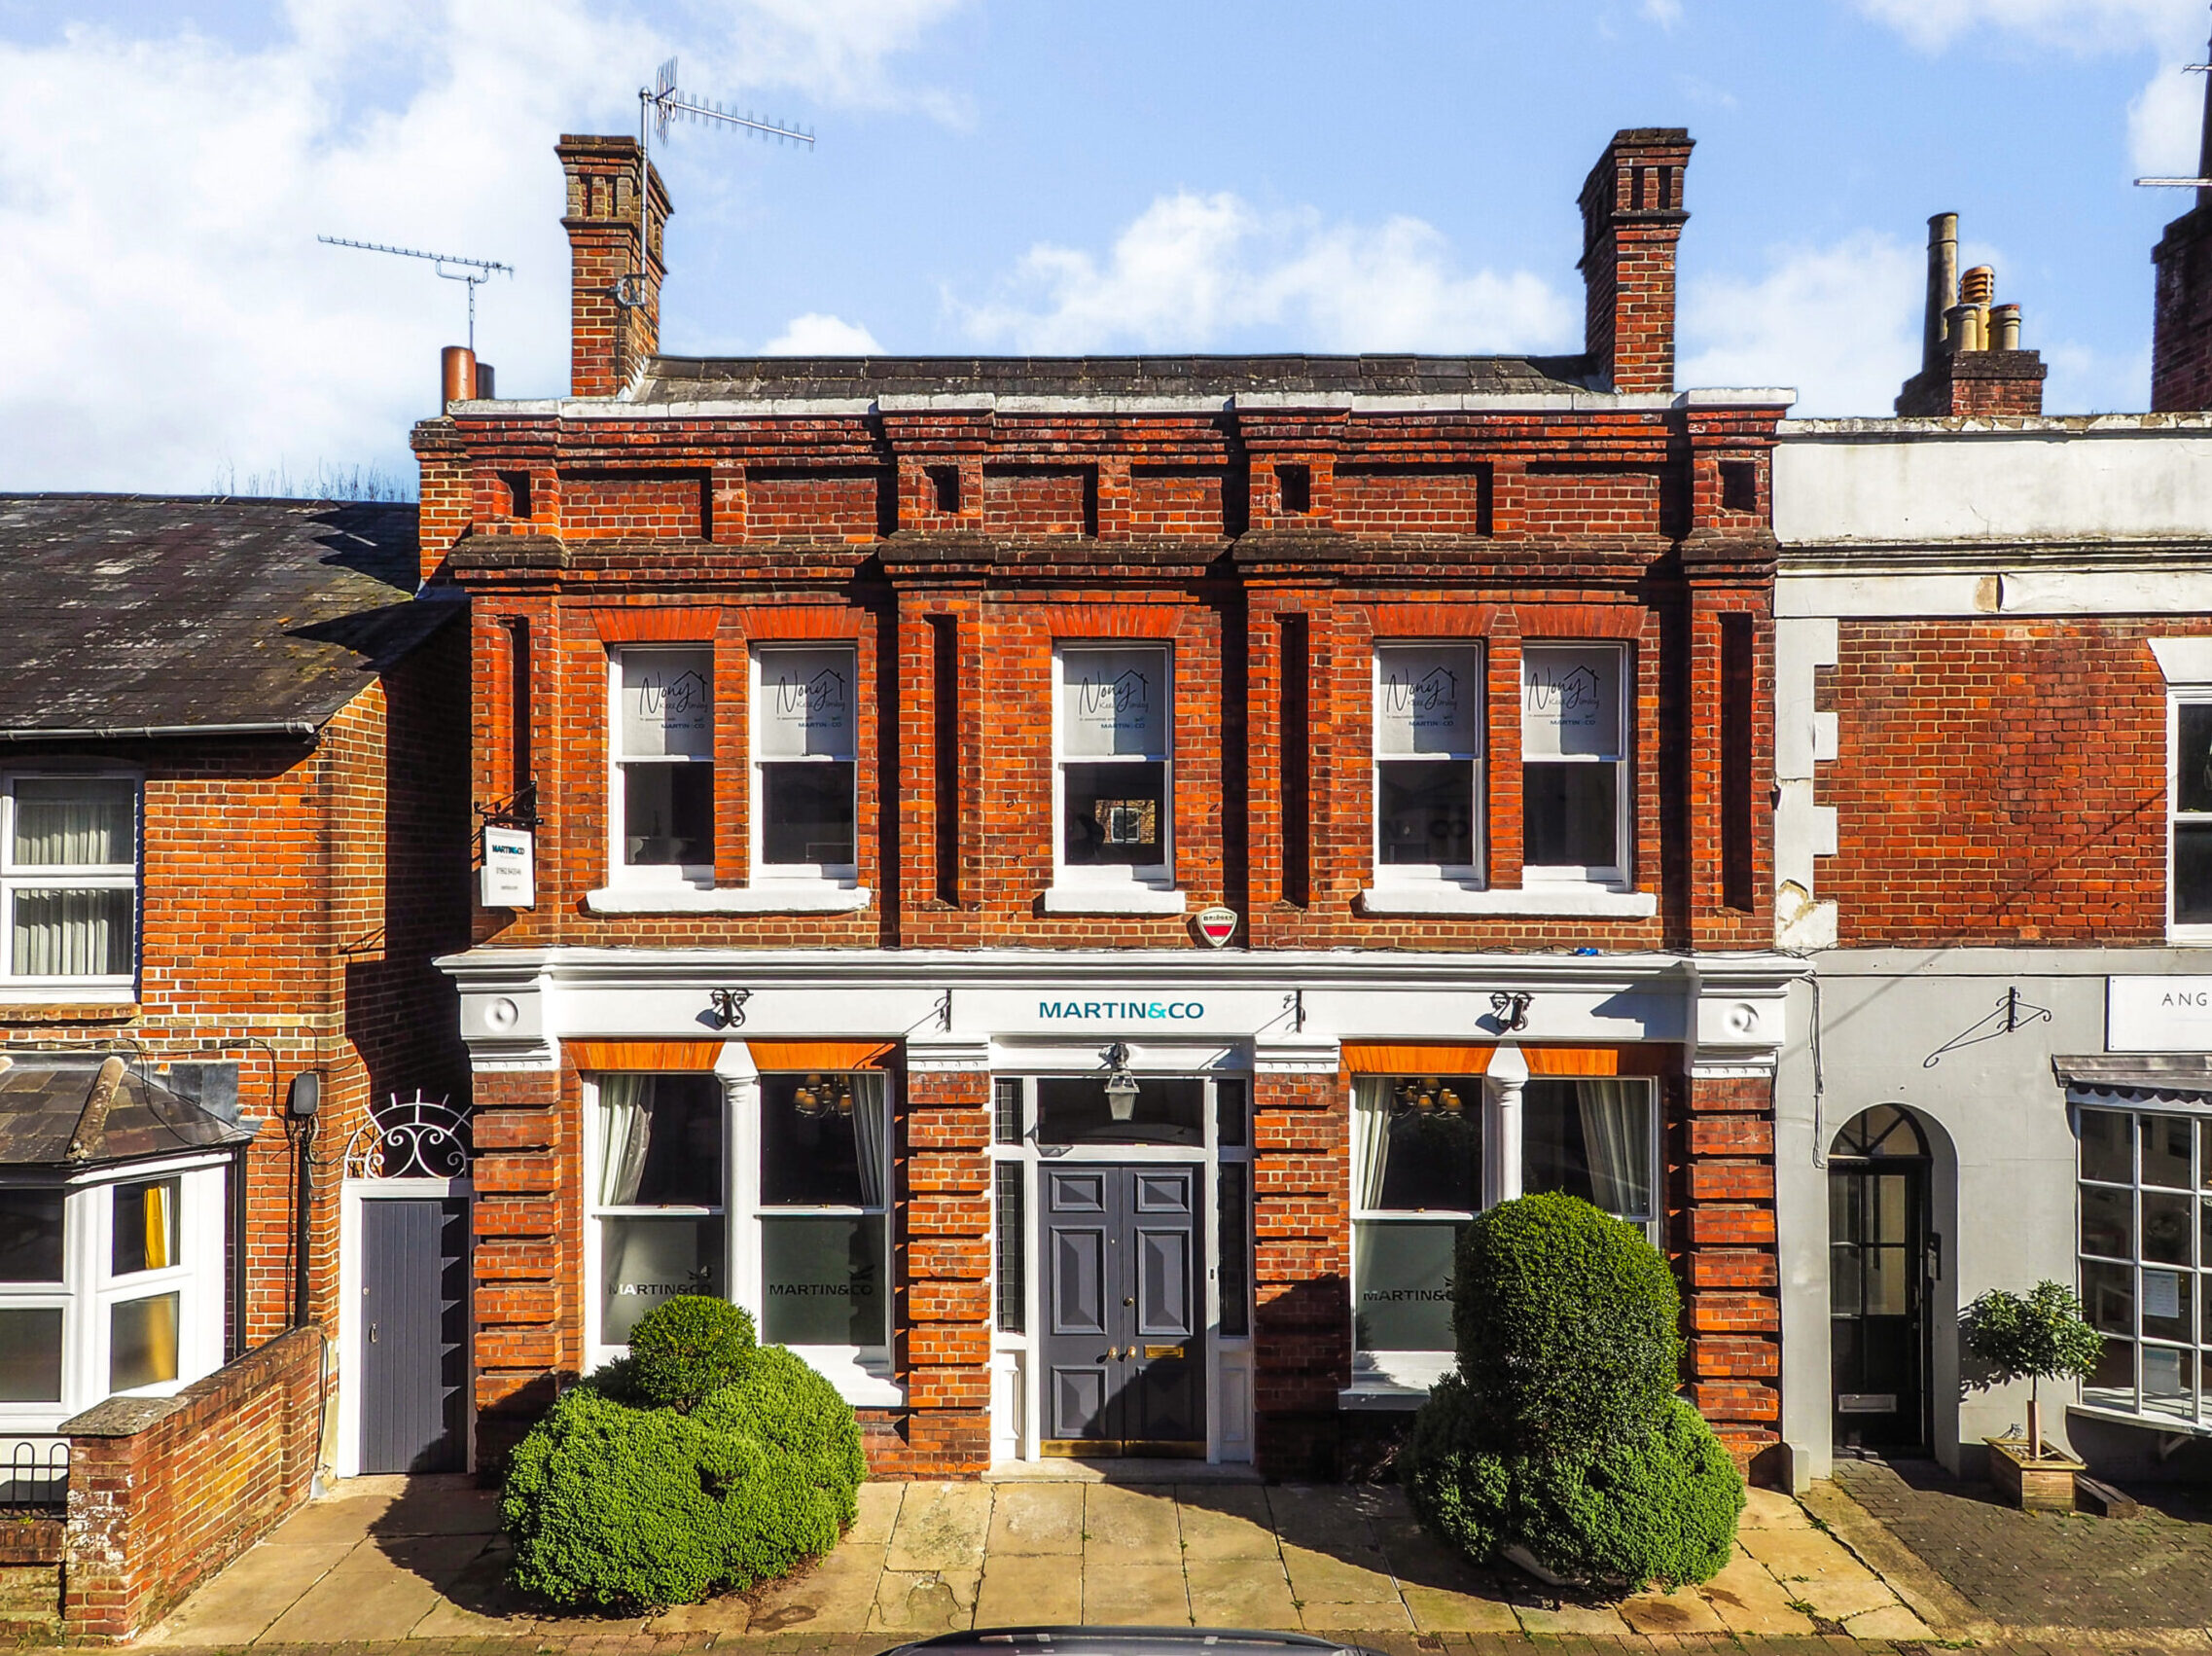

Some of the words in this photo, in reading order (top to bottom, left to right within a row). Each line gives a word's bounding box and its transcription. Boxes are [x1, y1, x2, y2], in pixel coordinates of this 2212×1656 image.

[639, 671, 696, 715] Nony
[776, 669, 834, 714] Nony
[1079, 670, 1136, 715] Nony
[1386, 668, 1445, 712] Nony
[1528, 666, 1588, 711] Nony
[1039, 1001, 1204, 1020] MARTIN&CO
[2161, 991, 2208, 1007] ANG
[608, 1282, 712, 1295] MARTIN&CO
[769, 1283, 874, 1295] MARTIN&CO
[1363, 1289, 1453, 1302] MARTIN&C
